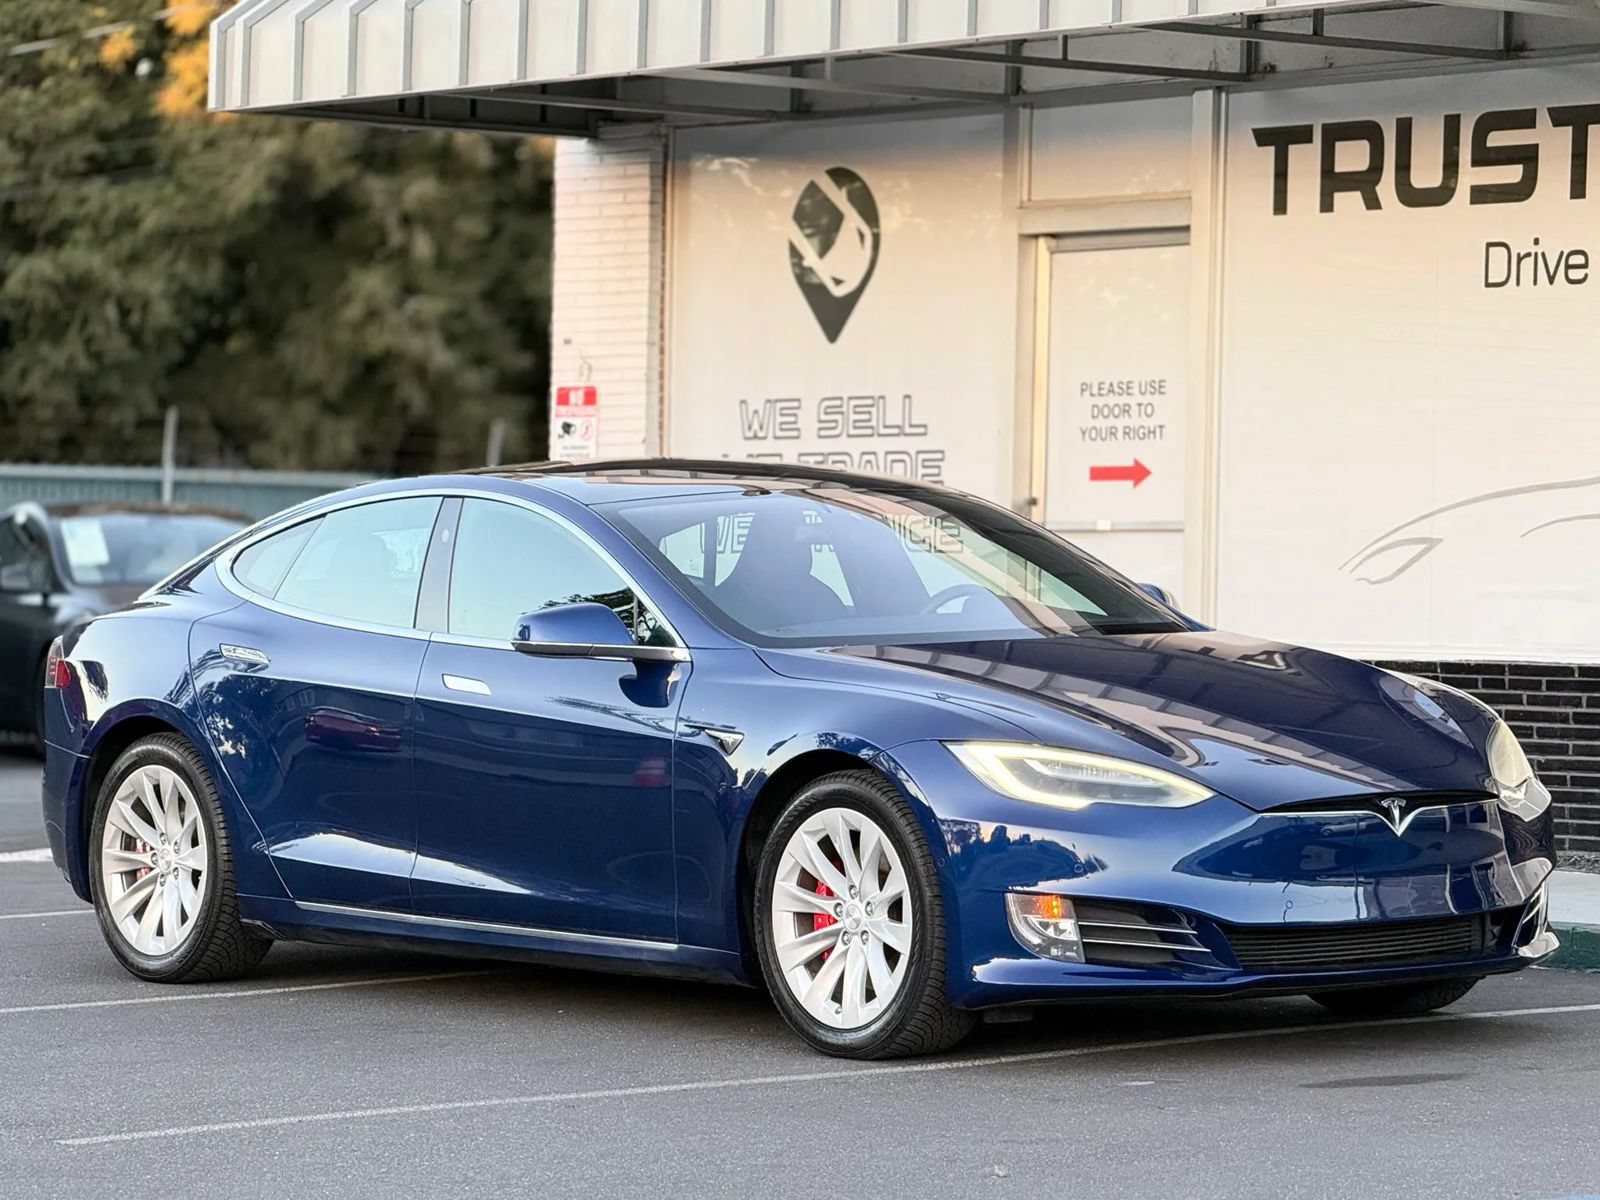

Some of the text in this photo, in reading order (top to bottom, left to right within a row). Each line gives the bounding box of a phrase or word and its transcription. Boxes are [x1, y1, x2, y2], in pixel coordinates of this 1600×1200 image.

[1251, 103, 1600, 216] TRUST
[1484, 237, 1590, 288] Drive
[1080, 379, 1167, 397] PLEASE USE
[739, 394, 928, 440] WE SELL
[1091, 402, 1155, 419] DOOR TO
[1079, 424, 1166, 442] YOUR RIGHT
